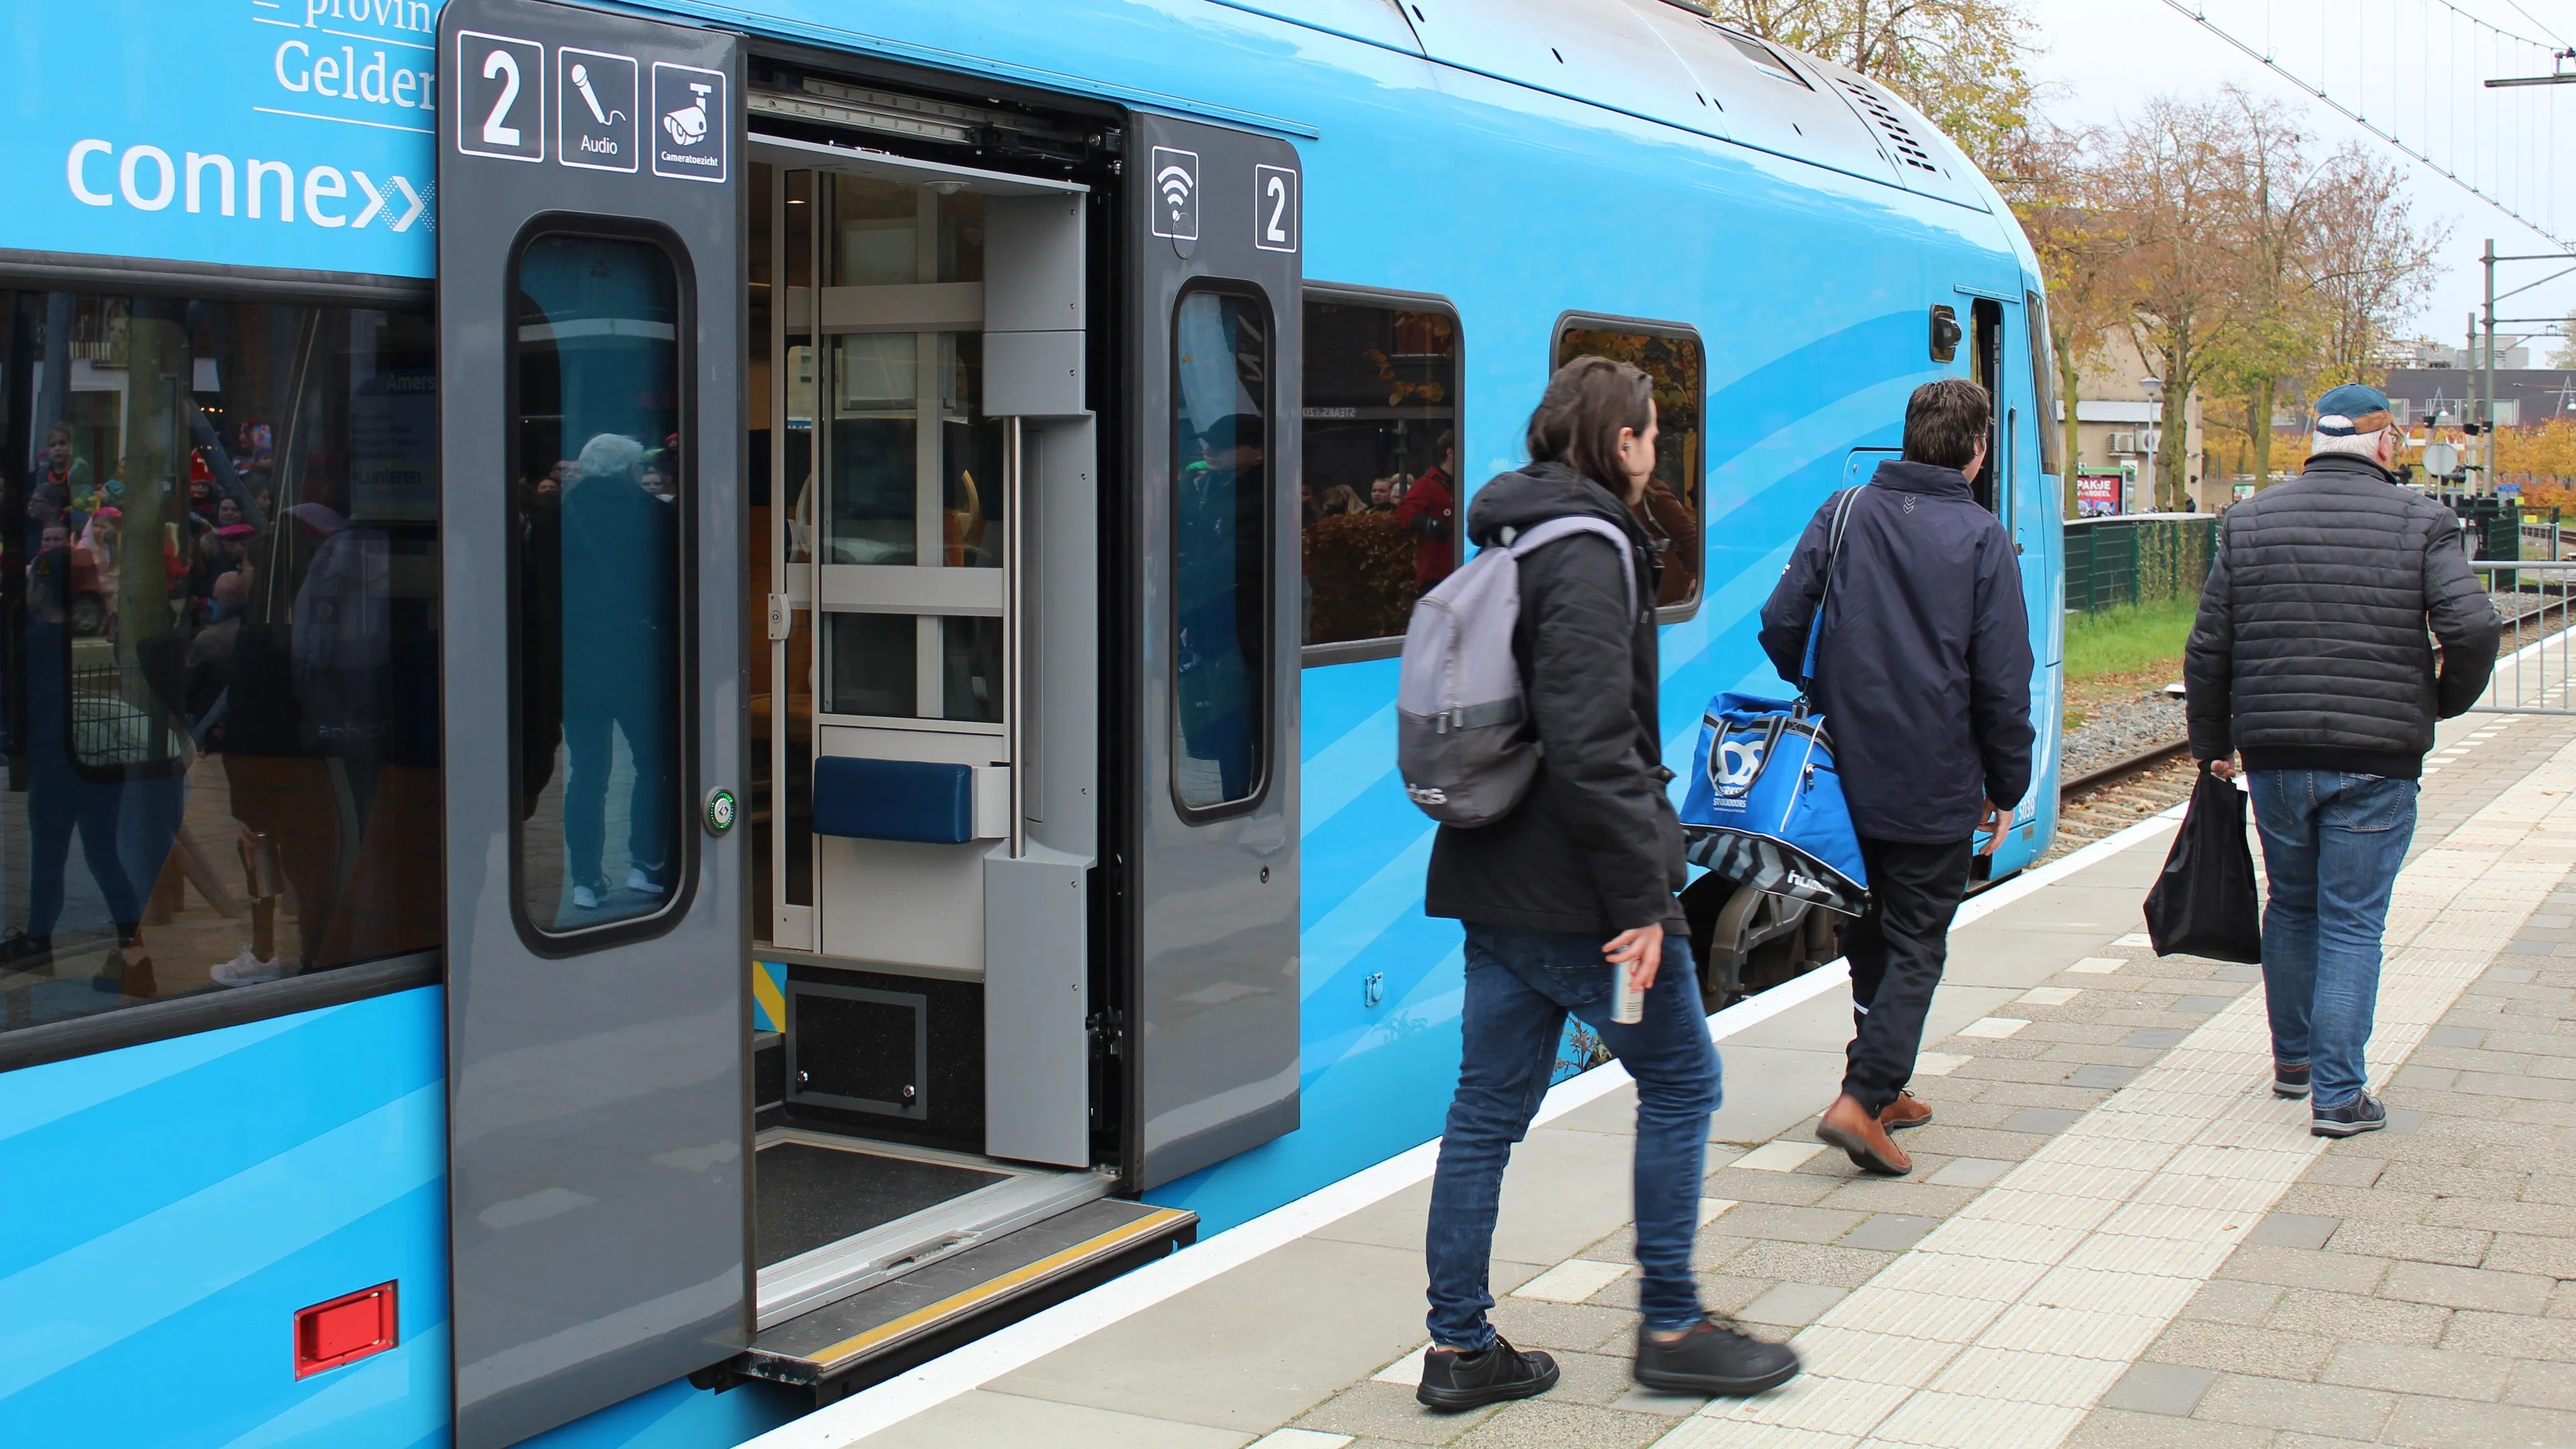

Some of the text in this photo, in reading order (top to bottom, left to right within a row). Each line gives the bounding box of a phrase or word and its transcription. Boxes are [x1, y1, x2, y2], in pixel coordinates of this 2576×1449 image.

[275, 40, 435, 111] Gelder
[483, 50, 520, 146] 2
[580, 135, 618, 155] Audio
[661, 151, 718, 167] Cameratoezicht
[1267, 176, 1285, 242] 2
[358, 468, 421, 484] Lunteren
[2018, 797, 2035, 821] 5039
